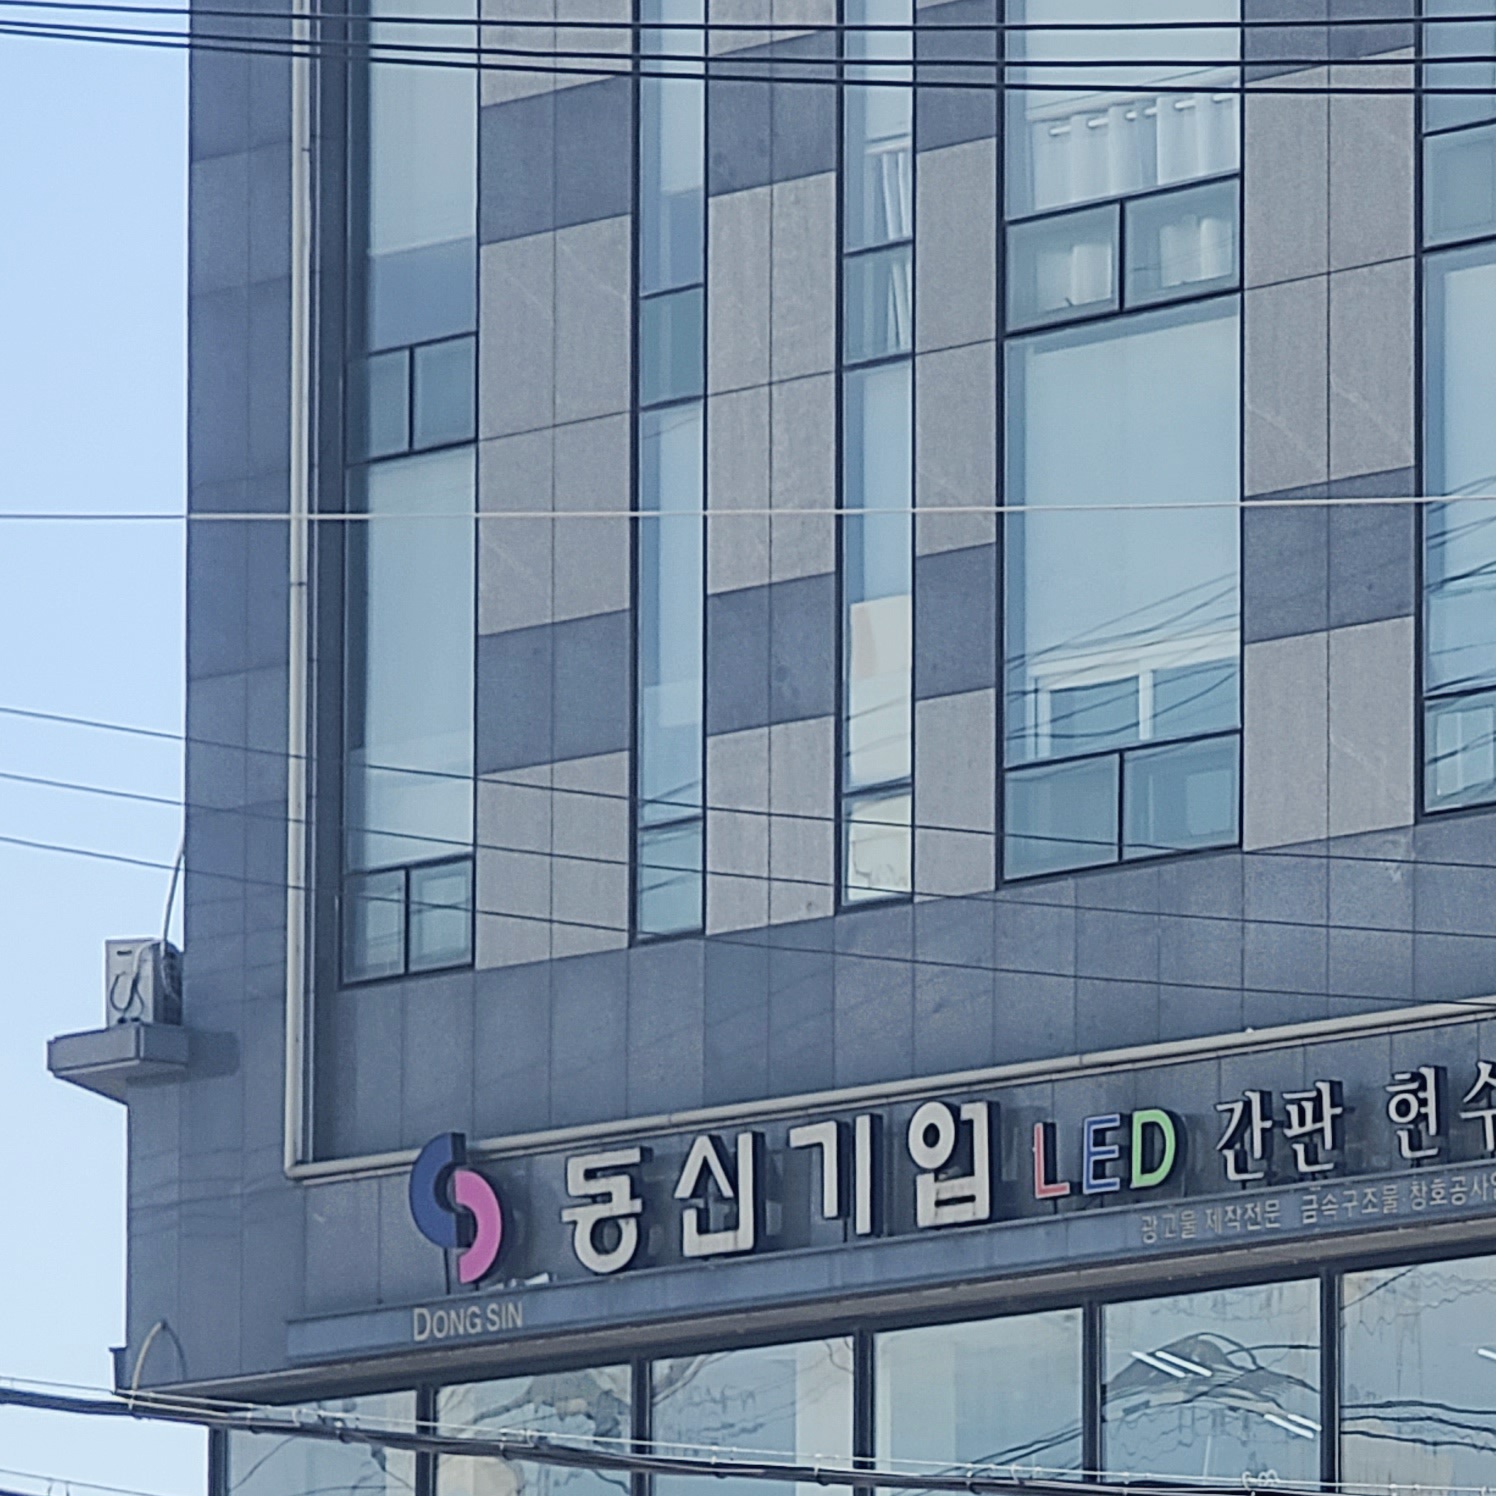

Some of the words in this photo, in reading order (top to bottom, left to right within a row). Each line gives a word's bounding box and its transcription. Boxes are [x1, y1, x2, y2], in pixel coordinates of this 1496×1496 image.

[561, 1100, 990, 1273] 동신기업
[1033, 1108, 1176, 1199] LED
[1215, 1081, 1344, 1182] 간판
[1140, 1212, 1198, 1244] 광고물
[1204, 1205, 1282, 1235] 제작전문
